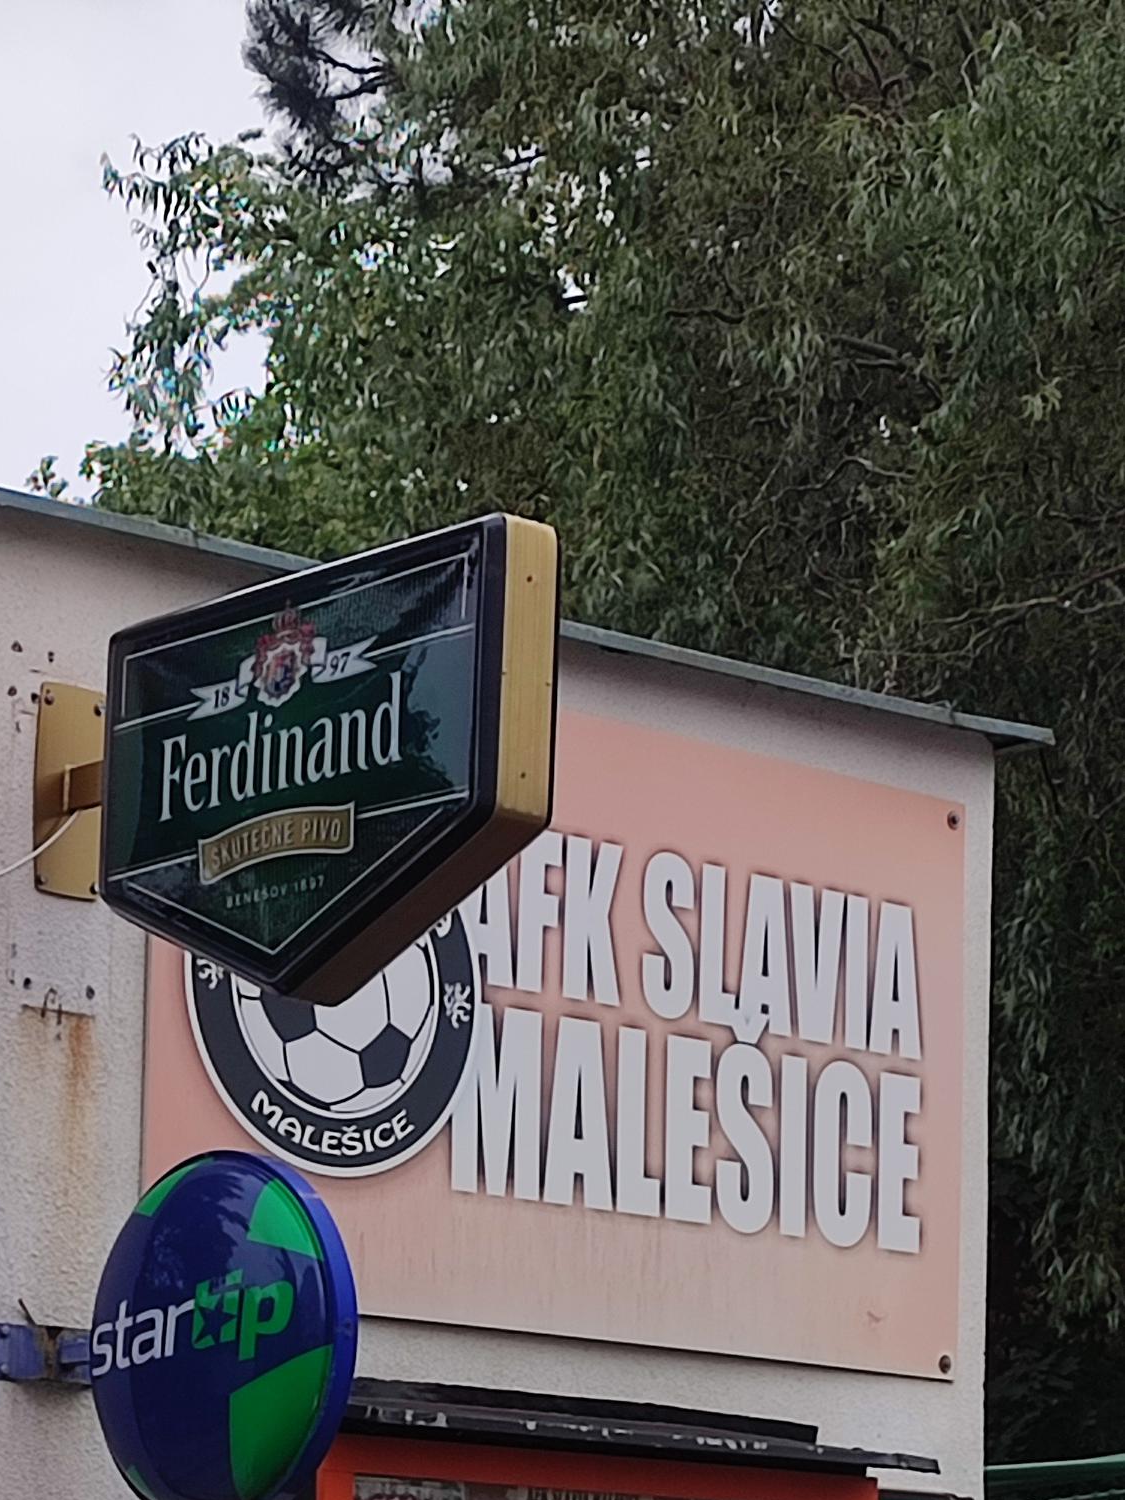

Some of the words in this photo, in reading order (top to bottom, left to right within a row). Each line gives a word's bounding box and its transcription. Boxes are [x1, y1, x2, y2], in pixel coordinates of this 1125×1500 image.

[213, 685, 231, 709] 18
[328, 651, 352, 675] 97
[157, 670, 403, 823] Ferdinand
[211, 818, 294, 869] SKUTEČNÉ
[300, 816, 342, 843] PIVO
[473, 832, 624, 1007] AFK
[641, 850, 923, 1062] SLAVIA
[250, 1090, 416, 1156] MALEŠICE
[450, 1002, 923, 1256] MALEŠICE
